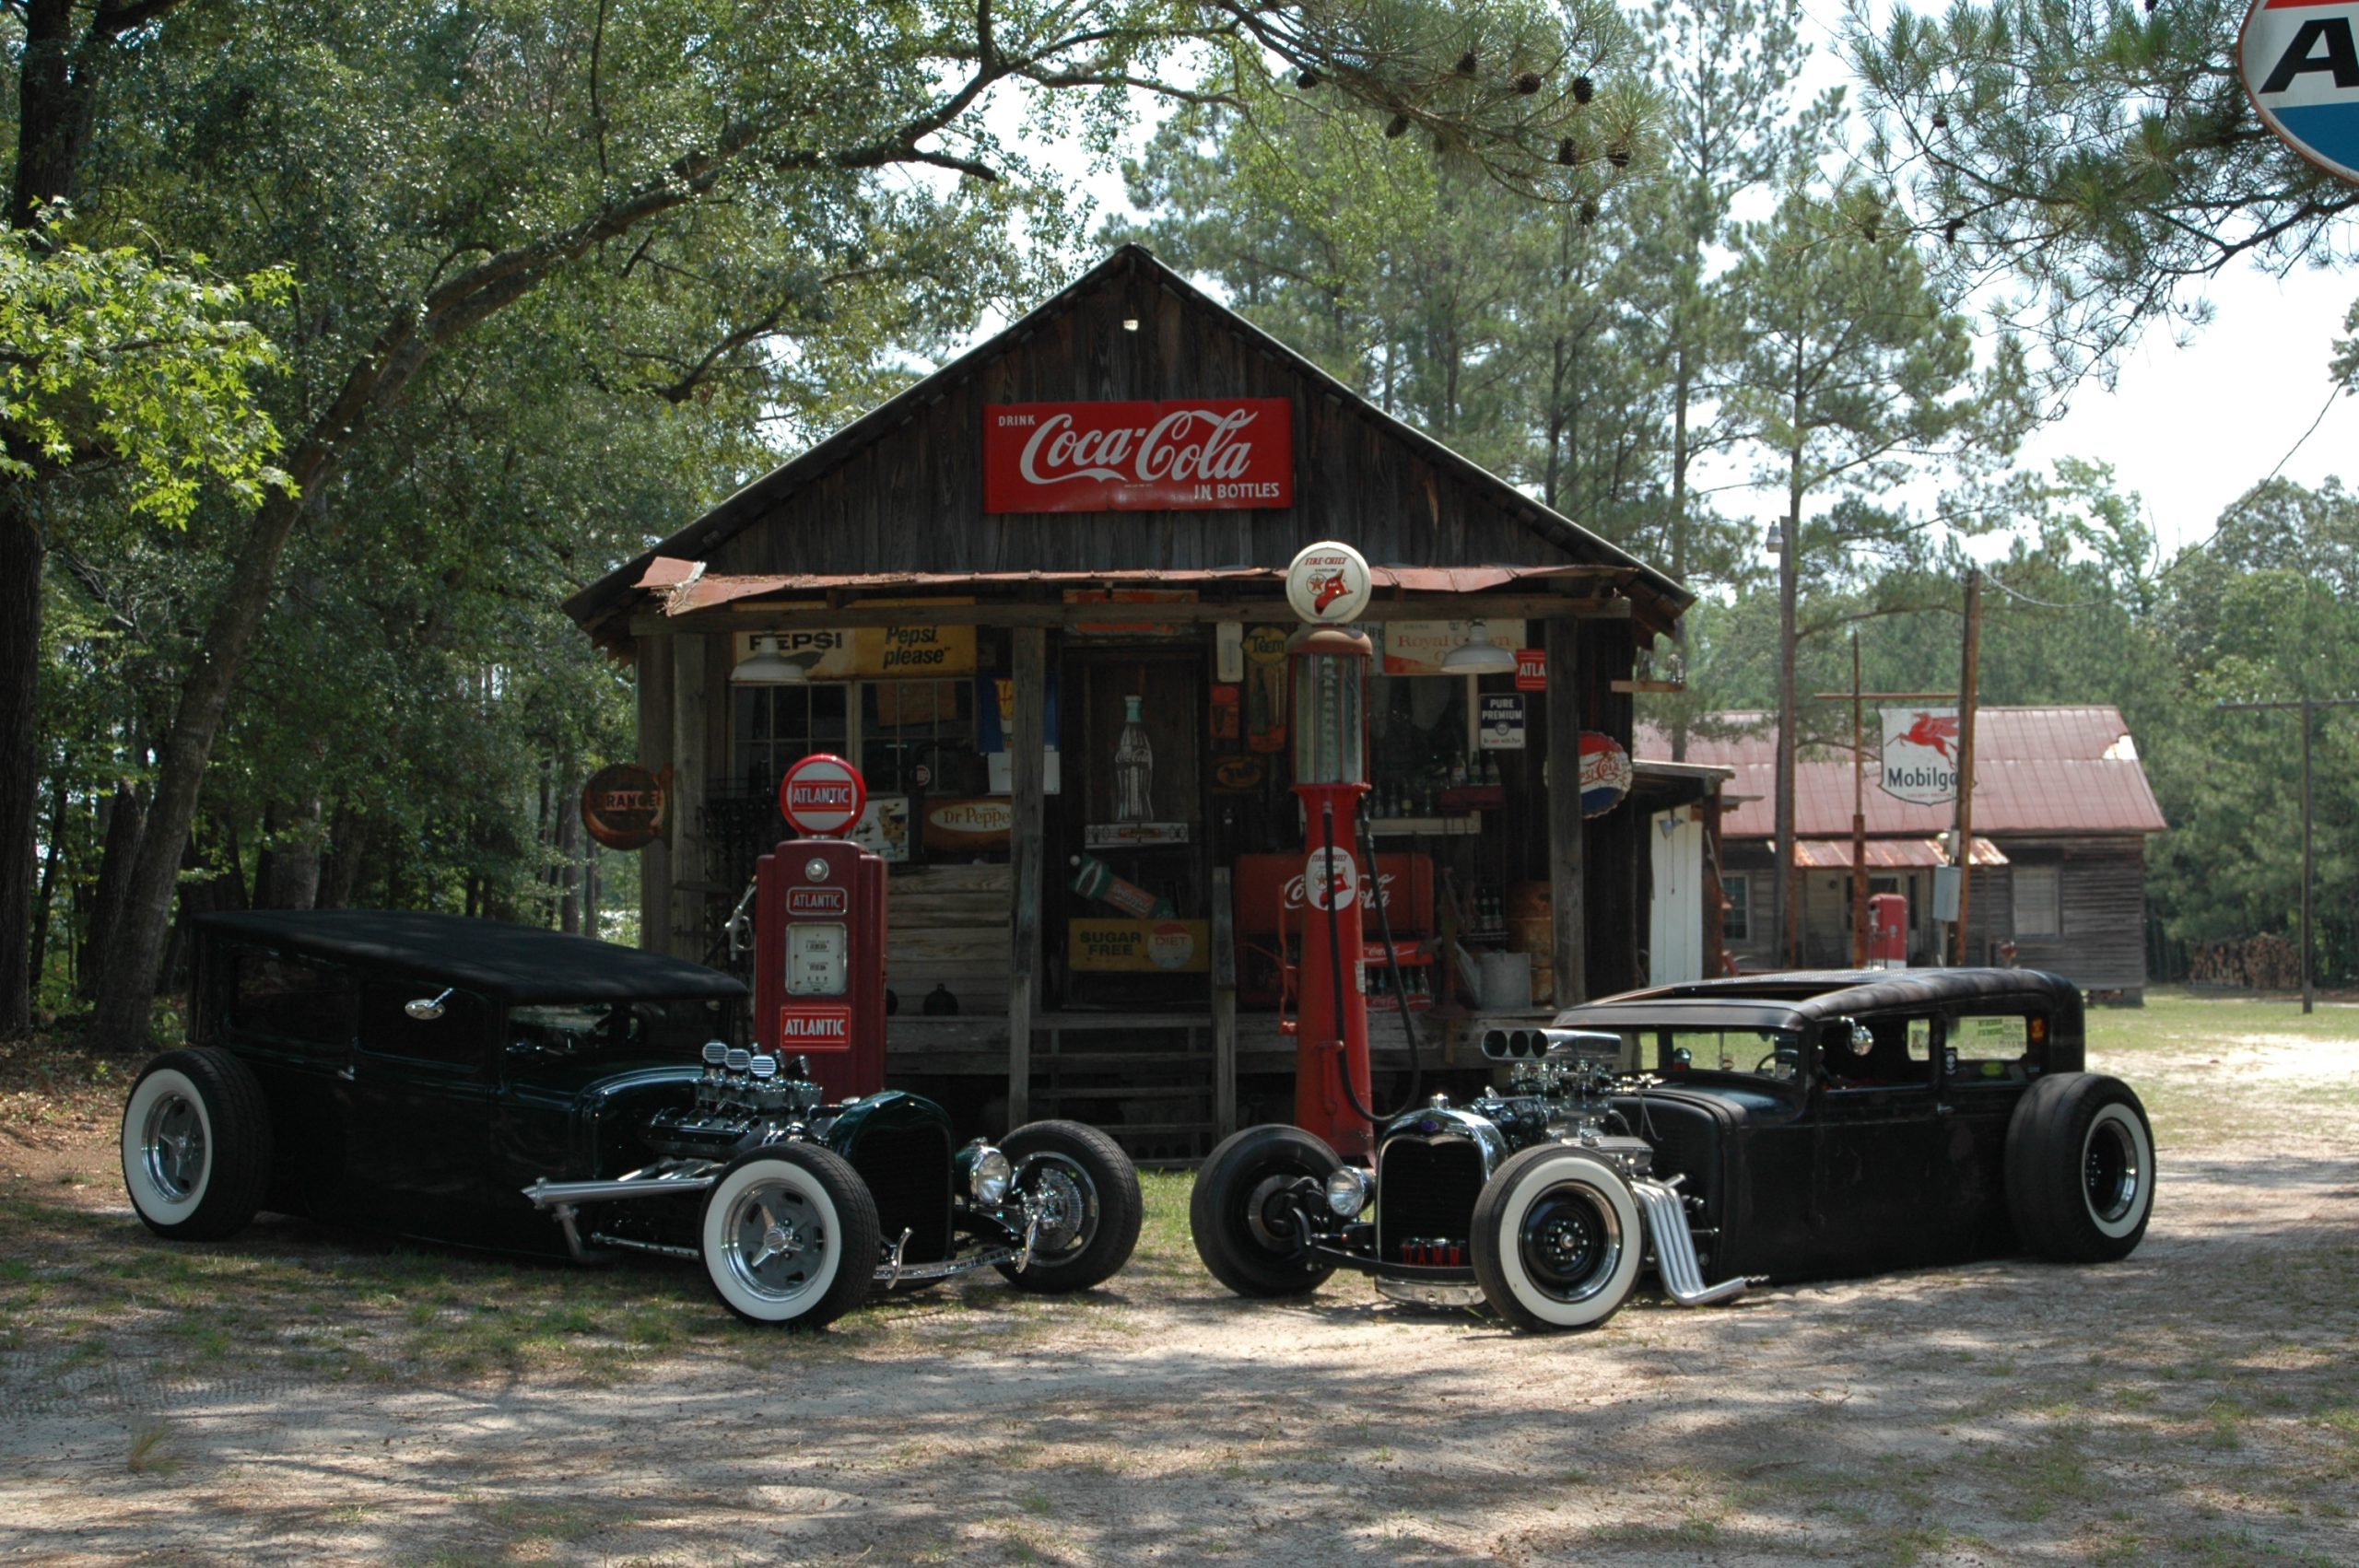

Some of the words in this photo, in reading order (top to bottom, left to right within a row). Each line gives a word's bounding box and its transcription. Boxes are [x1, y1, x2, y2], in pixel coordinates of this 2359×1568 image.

[998, 415, 1036, 427] DRINK
[1019, 408, 1259, 485] Coca-Cola
[1194, 484, 1213, 500] IN
[1217, 482, 1280, 498] BOTTLES
[1398, 634, 1449, 649] Royal
[1519, 661, 1546, 678] ATLA
[1489, 698, 1514, 708] PURE
[1482, 709, 1522, 720] PREMIUM
[793, 787, 850, 803] ATLANTIC
[944, 810, 962, 823] Dr
[966, 807, 1013, 827] Peppe
[792, 894, 841, 907] ATLANTIC
[1080, 931, 1142, 943] SUGAR
[1155, 936, 1187, 946] DIET
[1088, 943, 1133, 955] FREE
[784, 1018, 846, 1036] ATLANTIC
